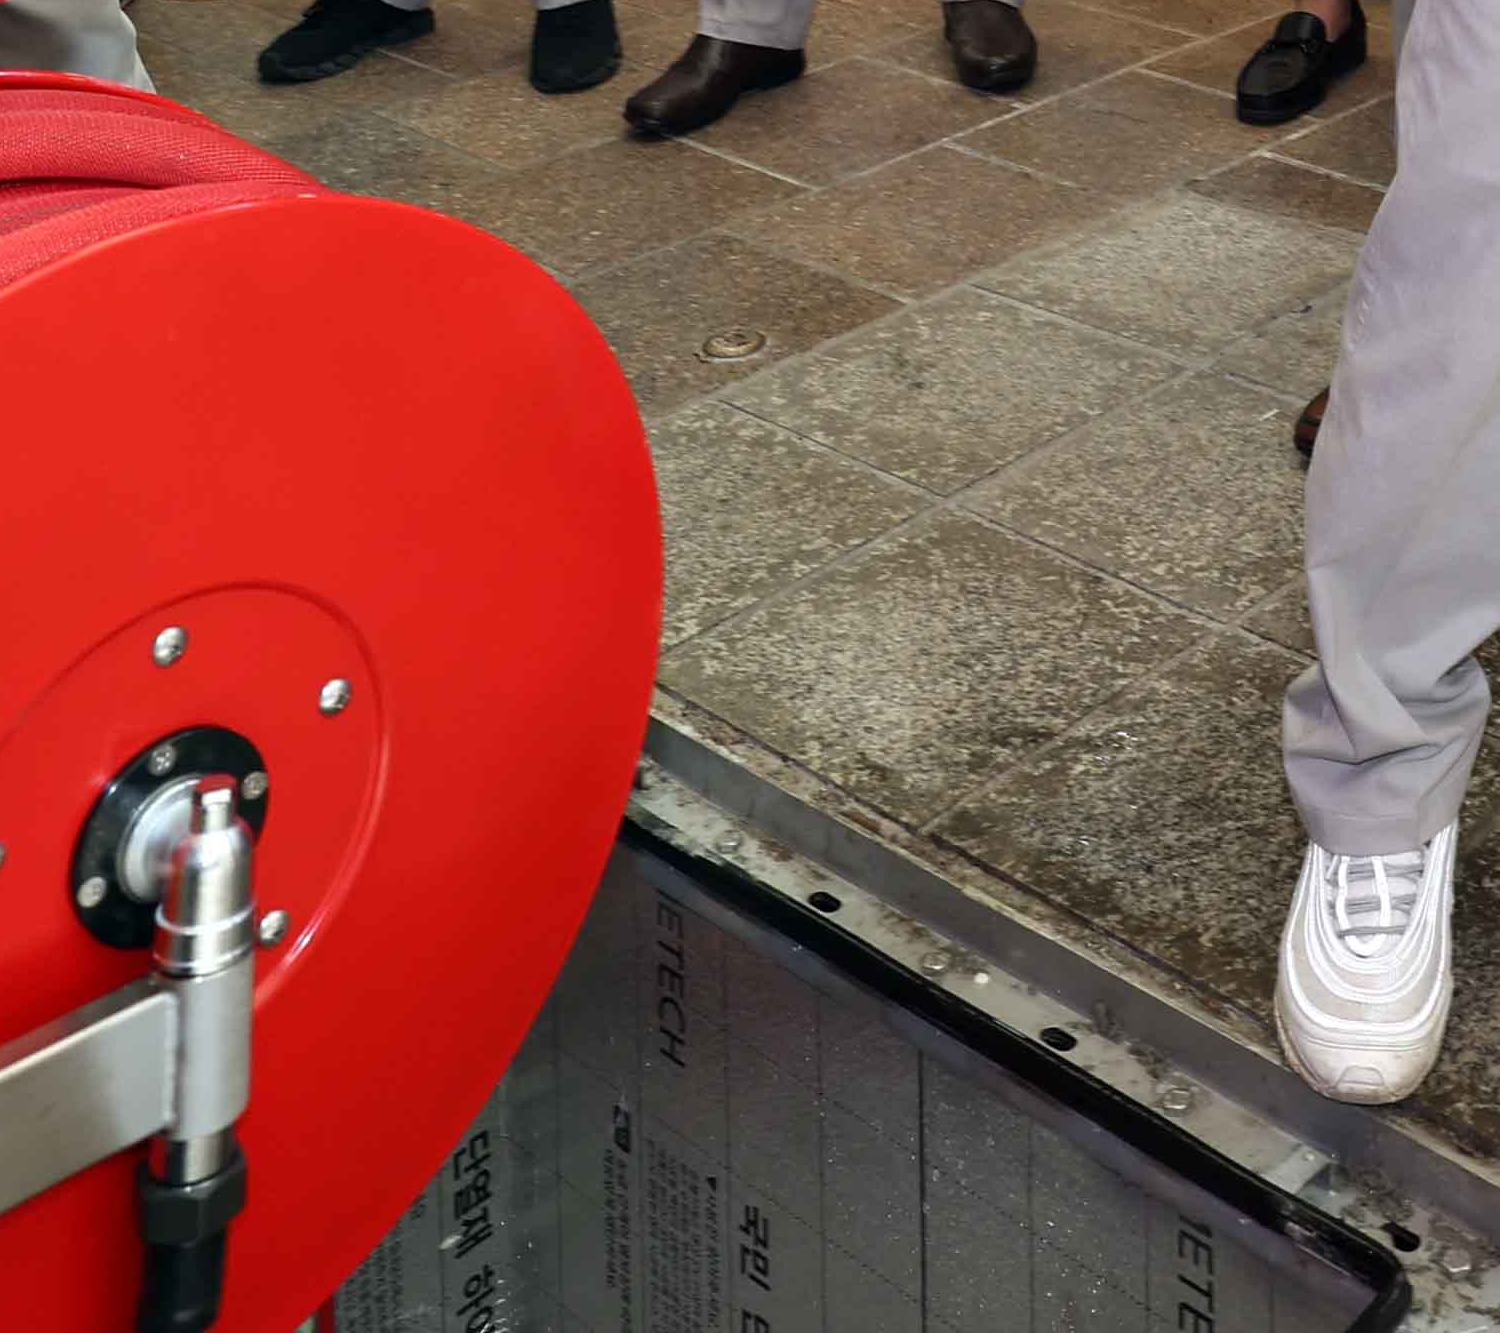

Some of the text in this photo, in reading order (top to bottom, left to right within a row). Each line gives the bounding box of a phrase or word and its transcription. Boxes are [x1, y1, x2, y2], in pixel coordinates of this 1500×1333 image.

[655, 891, 690, 1068] ETECH
[451, 1130, 492, 1259] 단열재
[738, 1204, 770, 1291] 국민
